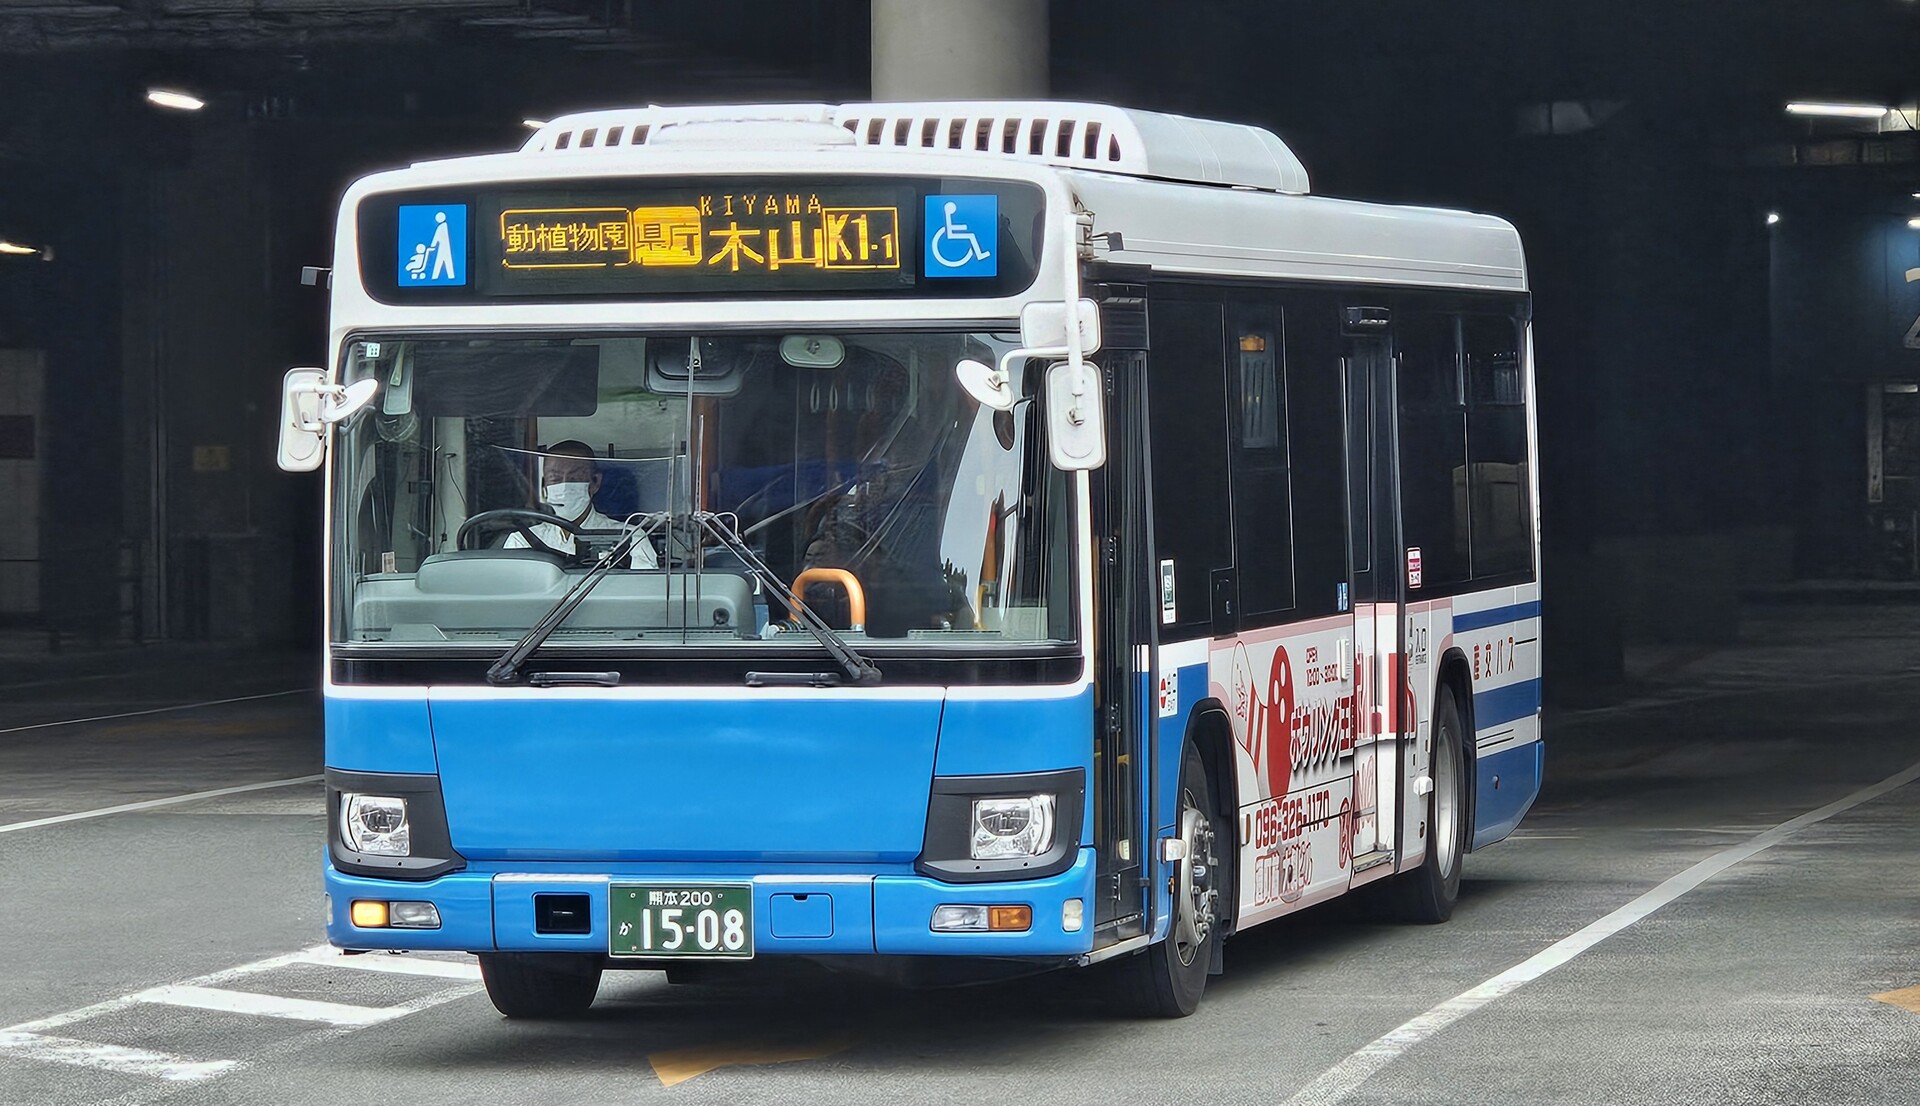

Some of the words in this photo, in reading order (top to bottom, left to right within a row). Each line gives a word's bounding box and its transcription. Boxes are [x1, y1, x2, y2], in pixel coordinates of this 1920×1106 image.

[700, 194, 822, 216] KIYAMA
[506, 222, 629, 253] 動植物園
[635, 222, 700, 257] 県庁
[708, 220, 823, 271] 木山
[618, 921, 633, 936] か
[642, 908, 746, 951] 15-08
